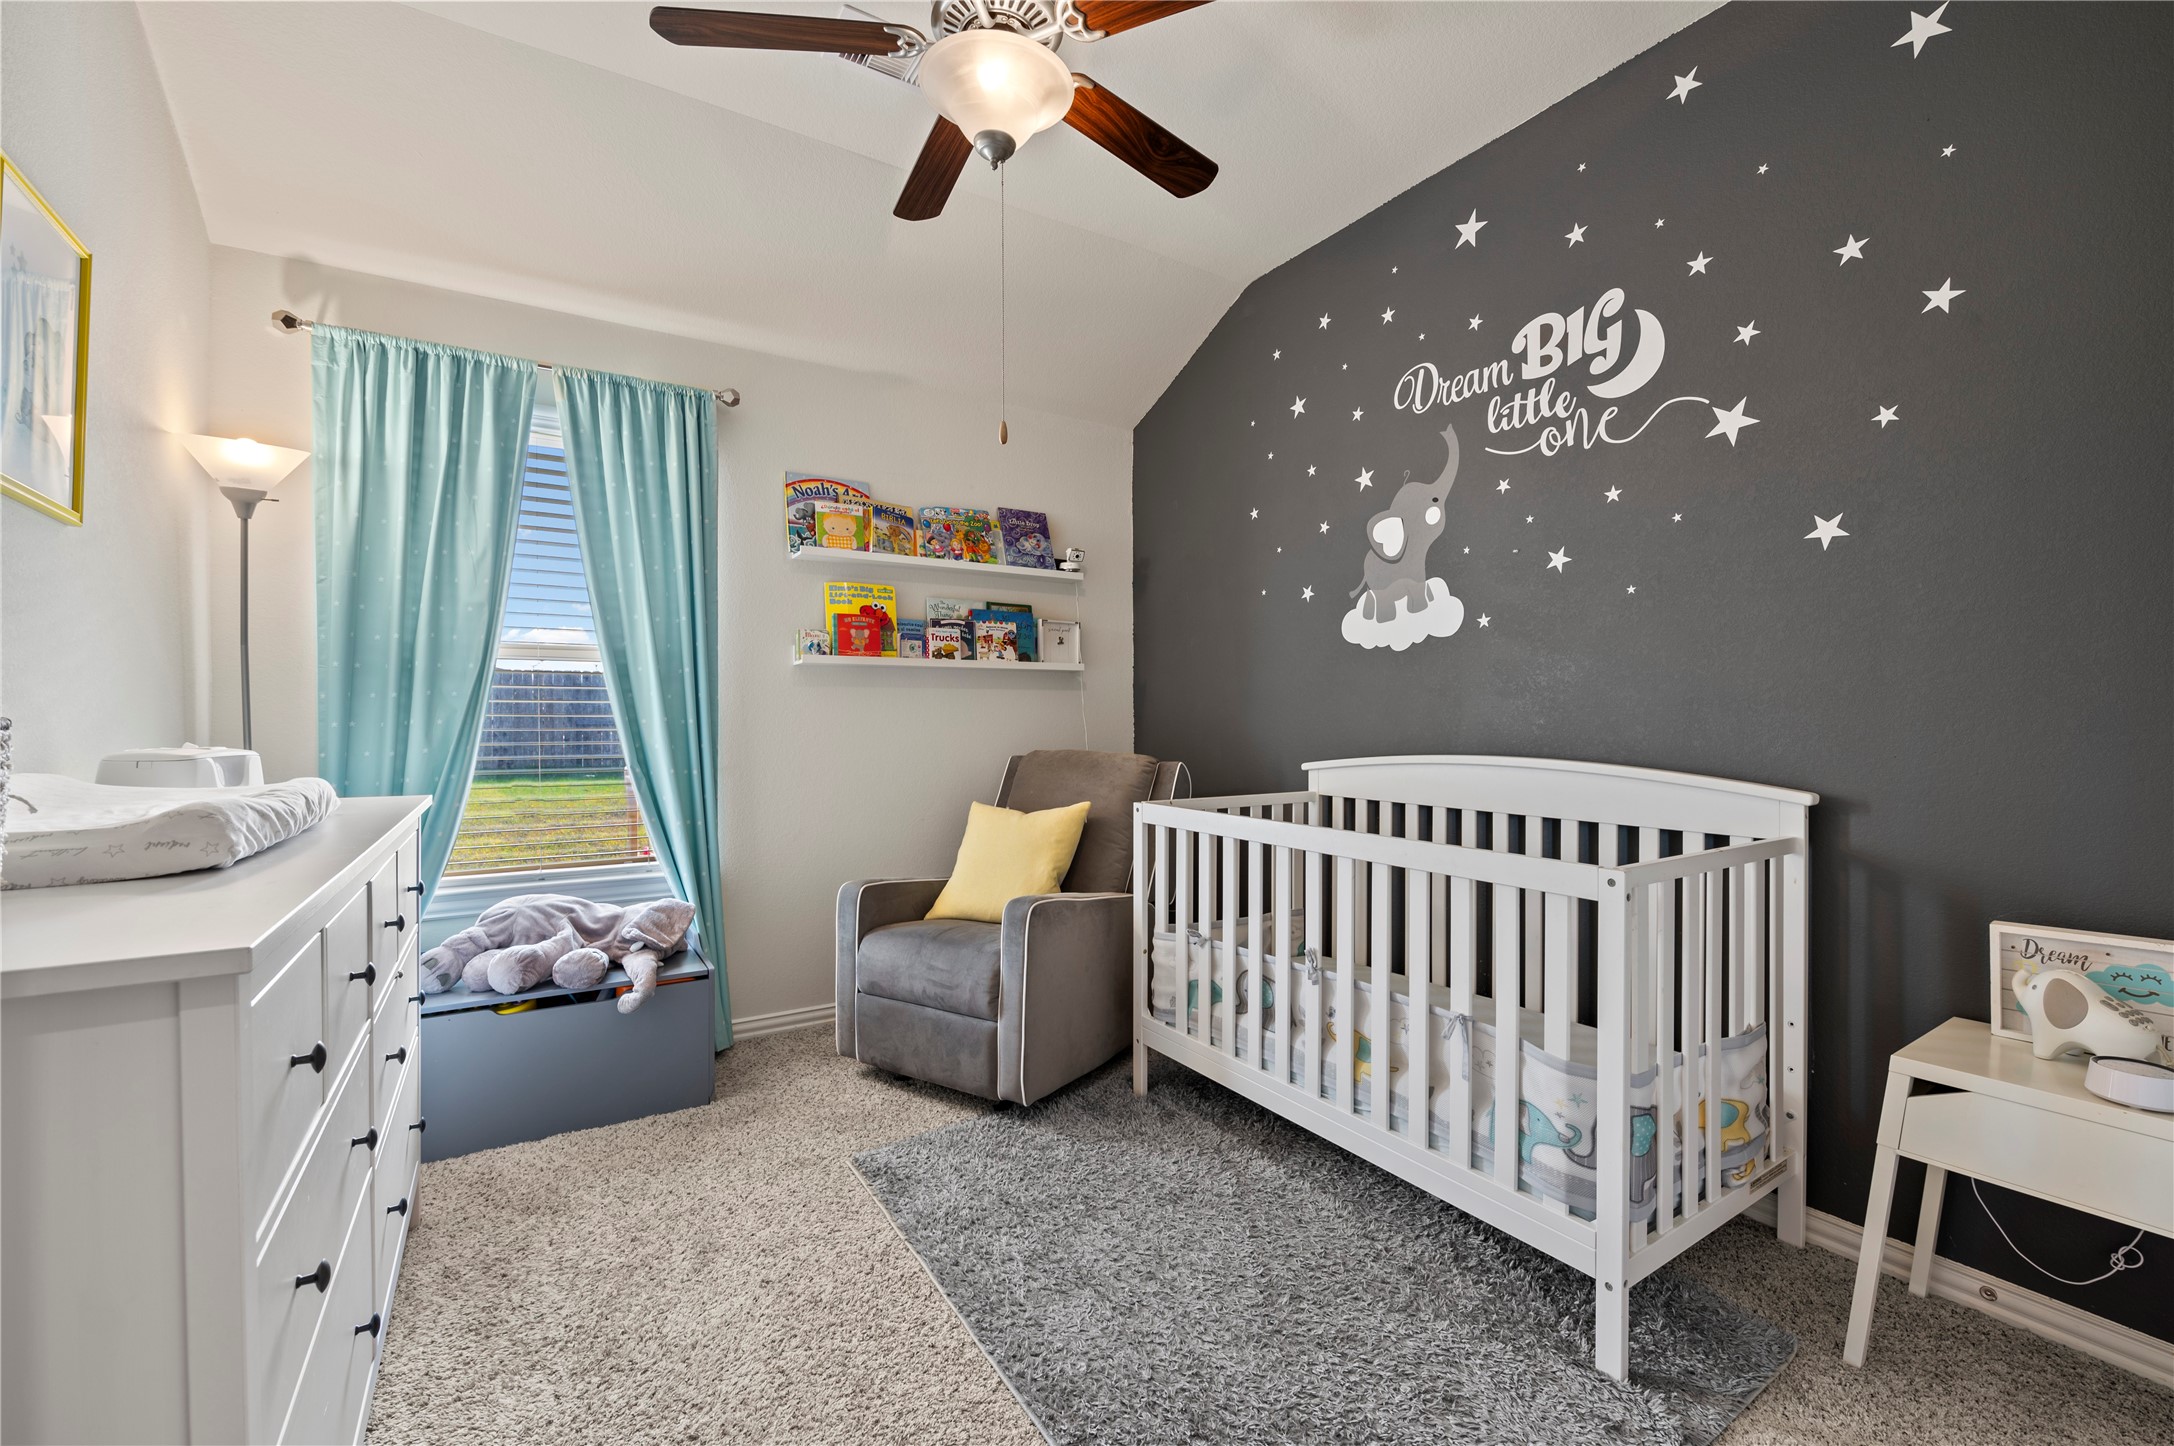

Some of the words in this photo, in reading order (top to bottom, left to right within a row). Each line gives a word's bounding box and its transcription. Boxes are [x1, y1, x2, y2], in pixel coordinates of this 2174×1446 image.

[1394, 360, 1513, 414] Dream
[1511, 287, 1625, 380] BIG
[1487, 377, 1577, 434] little
[791, 482, 838, 499] Noah's
[881, 512, 907, 526] BIBLIA
[931, 633, 960, 643] Trucks
[2020, 938, 2093, 971] Dream
